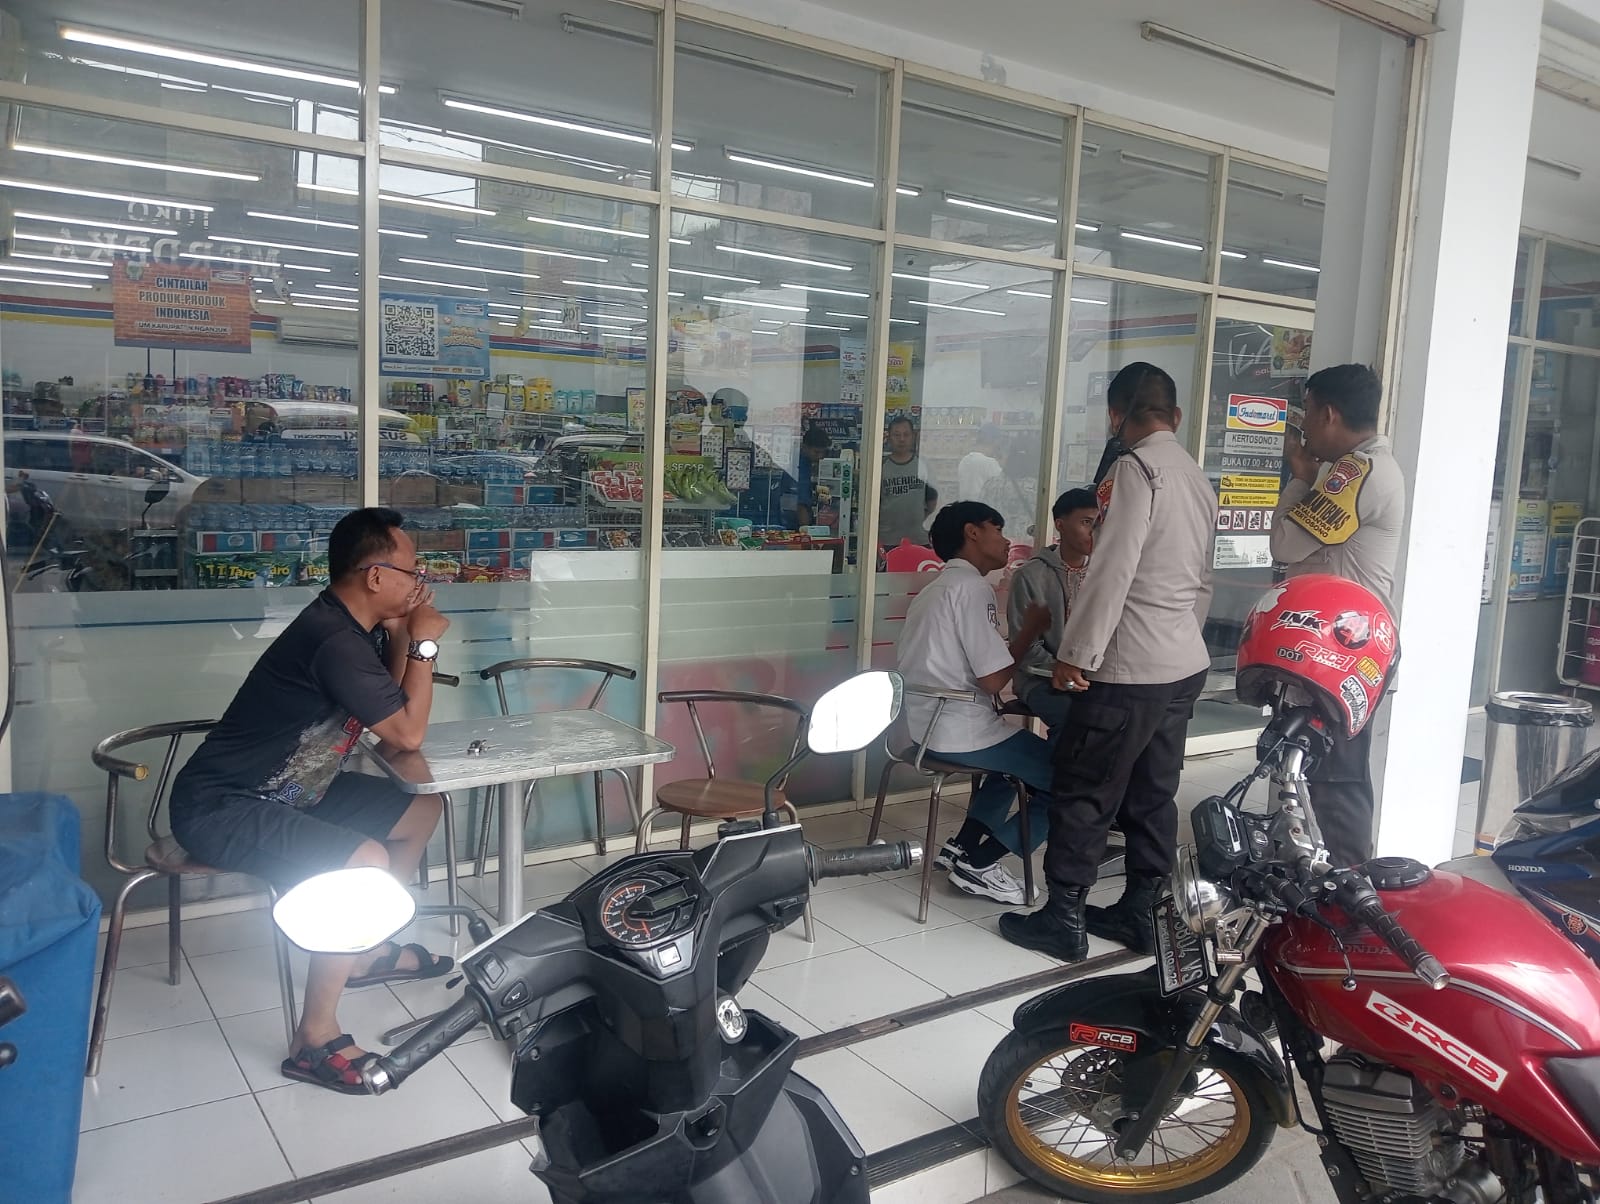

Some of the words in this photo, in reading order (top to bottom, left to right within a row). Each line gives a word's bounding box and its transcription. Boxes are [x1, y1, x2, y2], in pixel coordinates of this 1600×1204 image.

[156, 277, 208, 291] CINTAILAH
[139, 291, 226, 307] PRODUK-PRODUK
[156, 307, 210, 320] INDONESIA
[1239, 407, 1276, 420] Indomaret
[1231, 434, 1273, 445] KERTOSONO
[1273, 437, 1278, 445] 2
[1222, 456, 1242, 466] BUKA
[229, 565, 257, 580] Taro
[1277, 610, 1324, 630] INK
[1278, 648, 1302, 661] DOT
[1508, 864, 1546, 873] HONDA
[1327, 944, 1392, 955] HONDA
[1098, 1031, 1134, 1044] RCB
[1406, 1021, 1500, 1083] RCB
